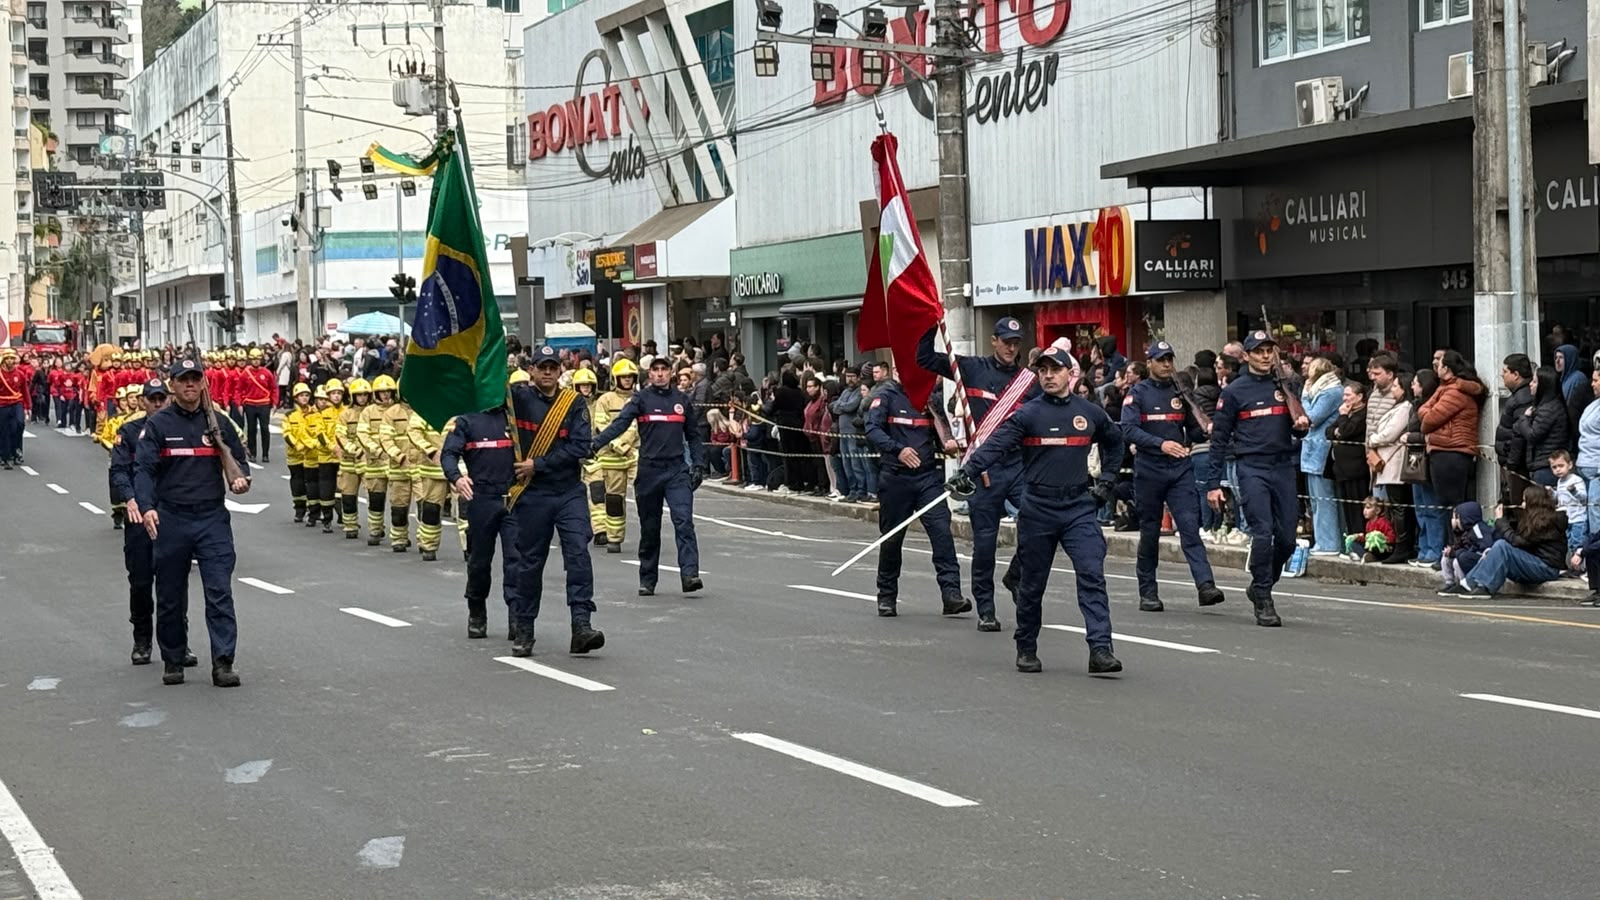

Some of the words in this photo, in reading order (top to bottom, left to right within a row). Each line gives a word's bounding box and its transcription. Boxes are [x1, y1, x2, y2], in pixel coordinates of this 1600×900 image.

[813, 0, 1071, 109] BONTO
[1285, 190, 1366, 225] CALLIARI
[1310, 224, 1366, 243] MUSICAL
[1144, 259, 1214, 271] CALLIARI
[1442, 270, 1467, 290] 345
